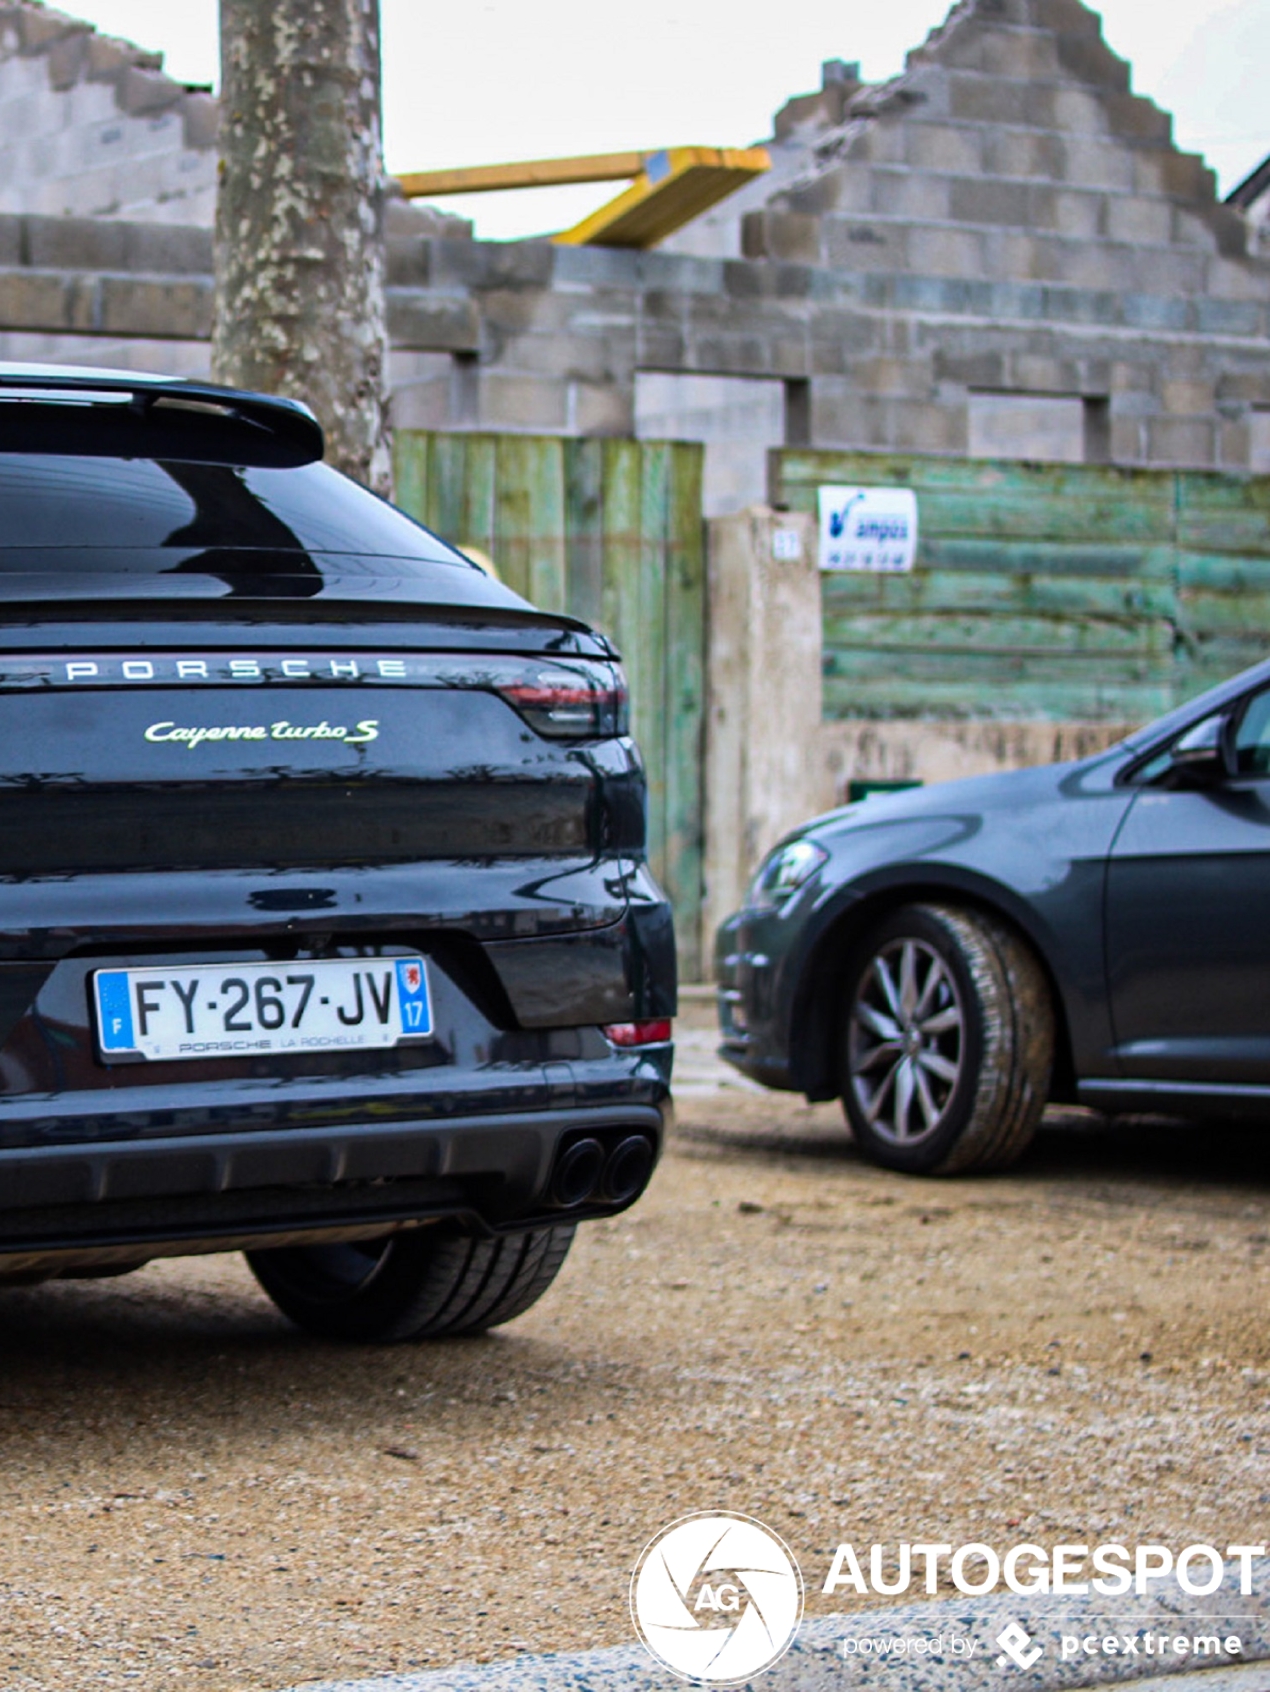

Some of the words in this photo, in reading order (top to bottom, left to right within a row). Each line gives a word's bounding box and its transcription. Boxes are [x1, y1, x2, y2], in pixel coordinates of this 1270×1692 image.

[66, 660, 406, 680] PORSCHE
[145, 722, 267, 748] Cayenne
[271, 720, 346, 739] turbo
[343, 720, 379, 742] S
[404, 1000, 423, 1027] 17
[112, 1018, 122, 1034] F
[179, 1039, 271, 1053] PORSCHE
[281, 1038, 296, 1048] LA
[301, 1034, 365, 1047] ROCHELLE
